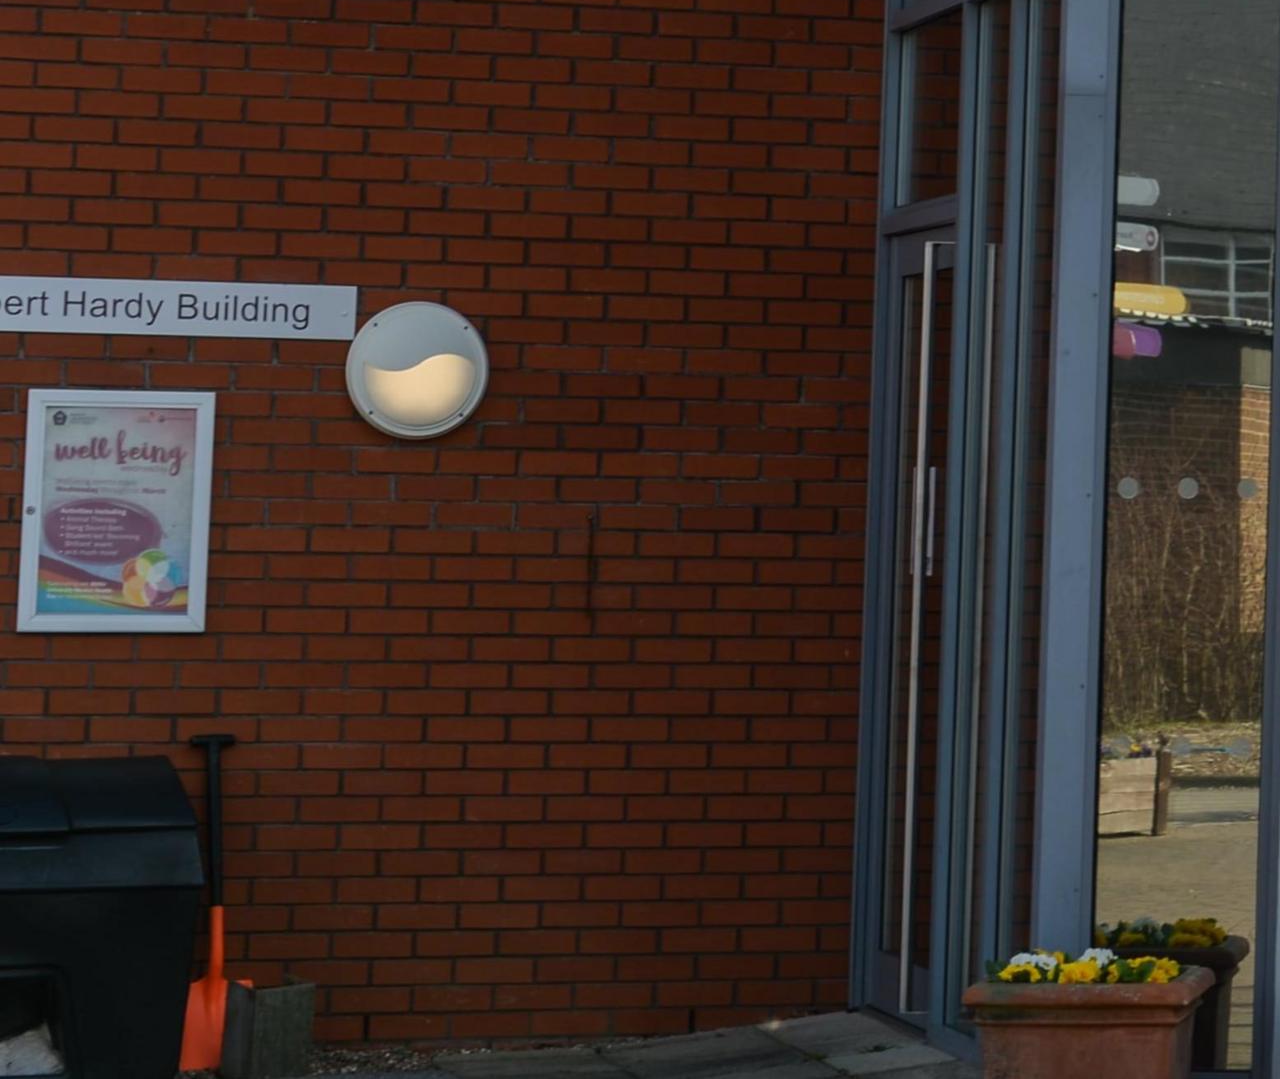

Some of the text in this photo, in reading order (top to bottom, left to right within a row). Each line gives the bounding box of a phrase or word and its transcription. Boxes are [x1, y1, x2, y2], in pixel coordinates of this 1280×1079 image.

[0, 290, 311, 330] ert Hardy Building
[54, 430, 187, 476] well being
